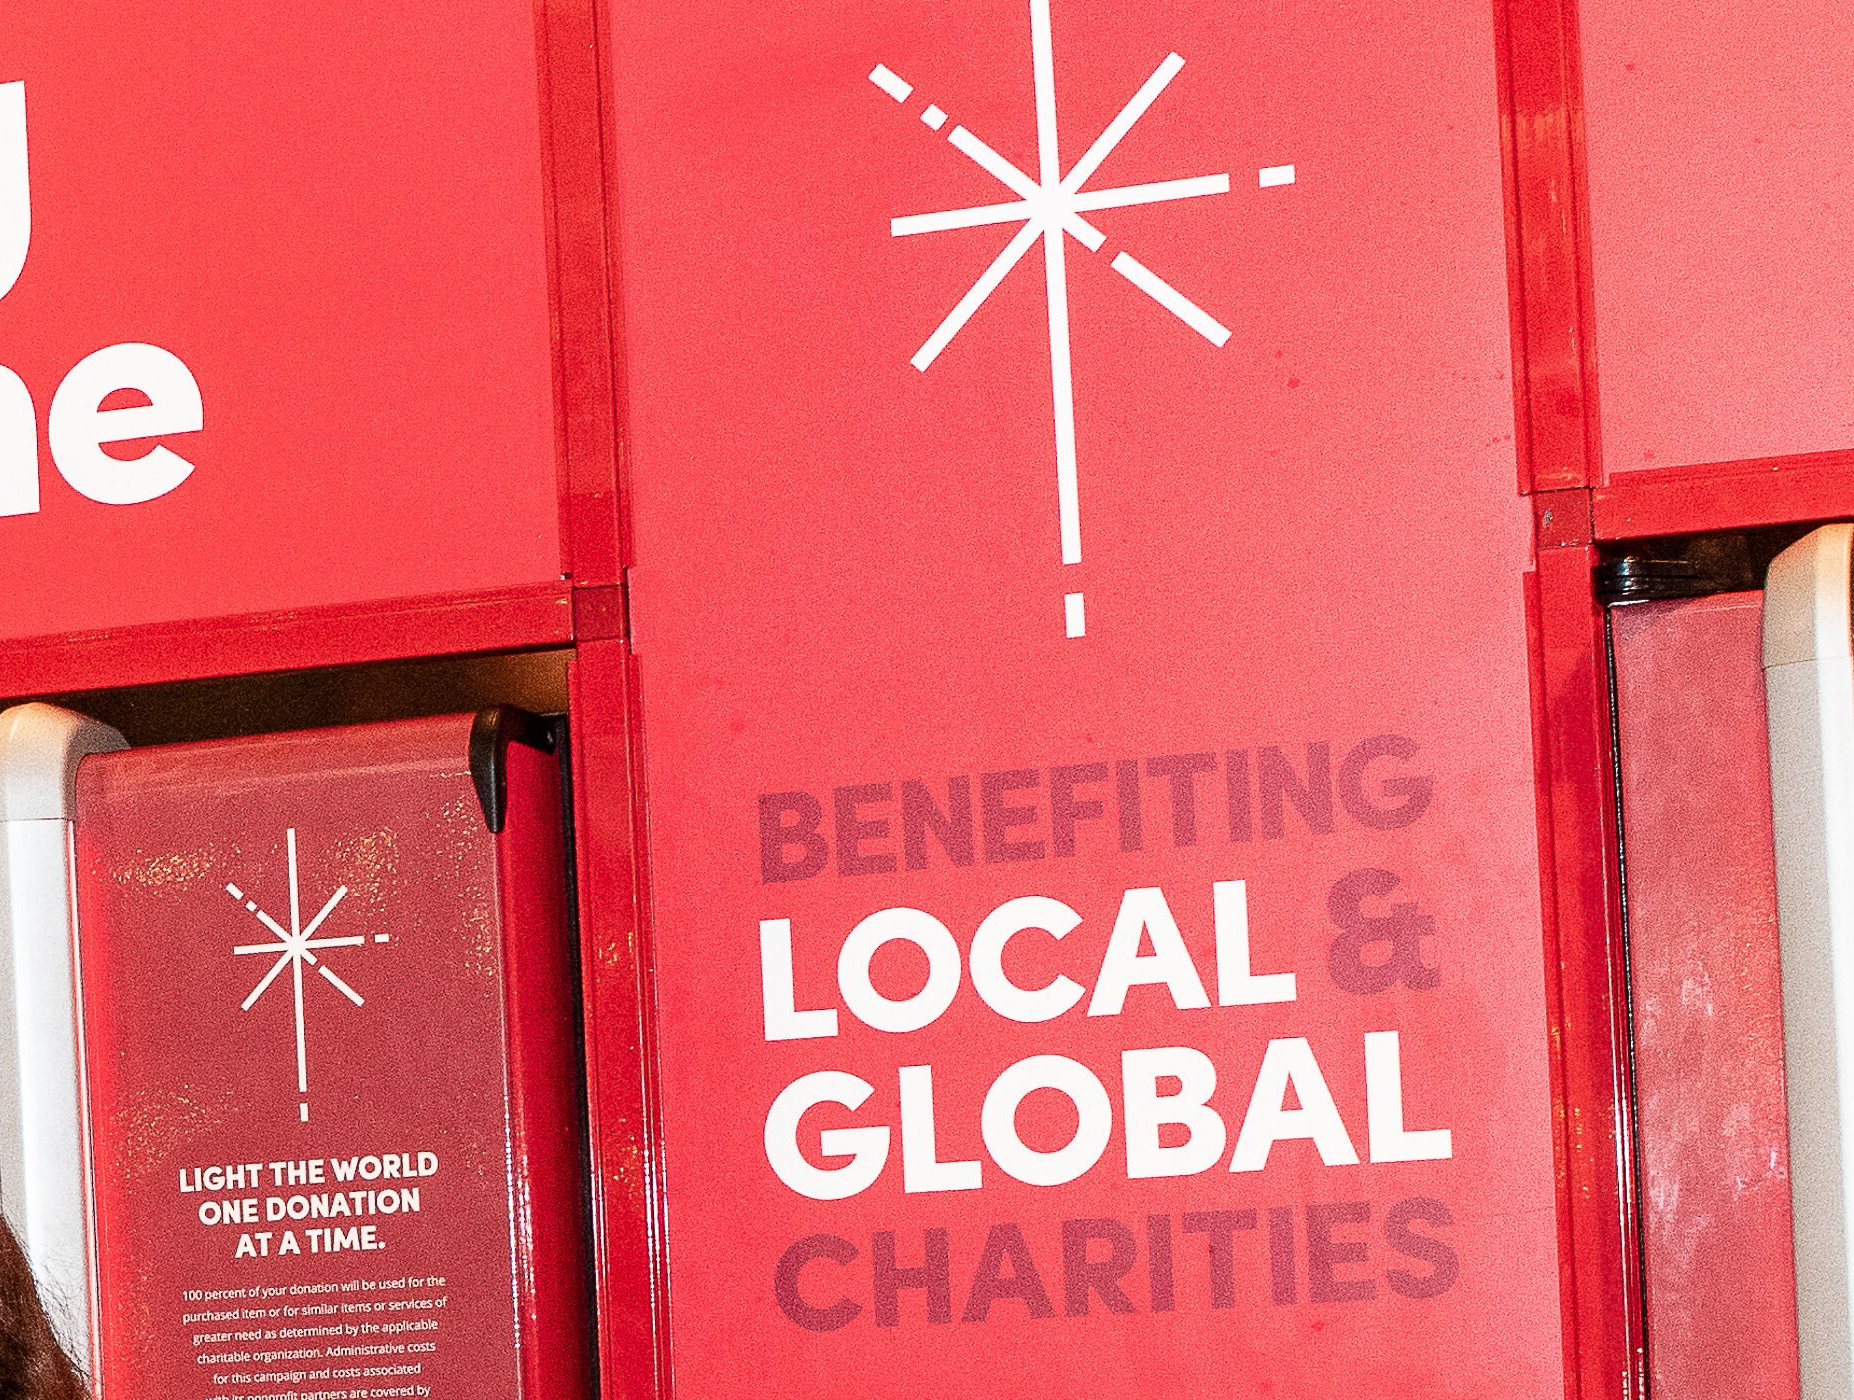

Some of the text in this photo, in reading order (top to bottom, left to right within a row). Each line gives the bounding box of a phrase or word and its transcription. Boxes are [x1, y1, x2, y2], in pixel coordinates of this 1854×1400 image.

[758, 734, 1436, 885] BENEFITING
[760, 867, 1441, 1042] LOCAL &
[763, 1030, 1453, 1201] GLOBAL
[178, 1151, 439, 1193] LIGHT THE WORLD
[198, 1187, 421, 1226] ONE DONATION
[235, 1224, 386, 1259] AT A TIME.
[774, 1197, 1460, 1333] CHARITIES
[182, 1275, 446, 1302] 100 percent of your donation will be used for the
[182, 1295, 448, 1325] purchased item or for similar items or services of
